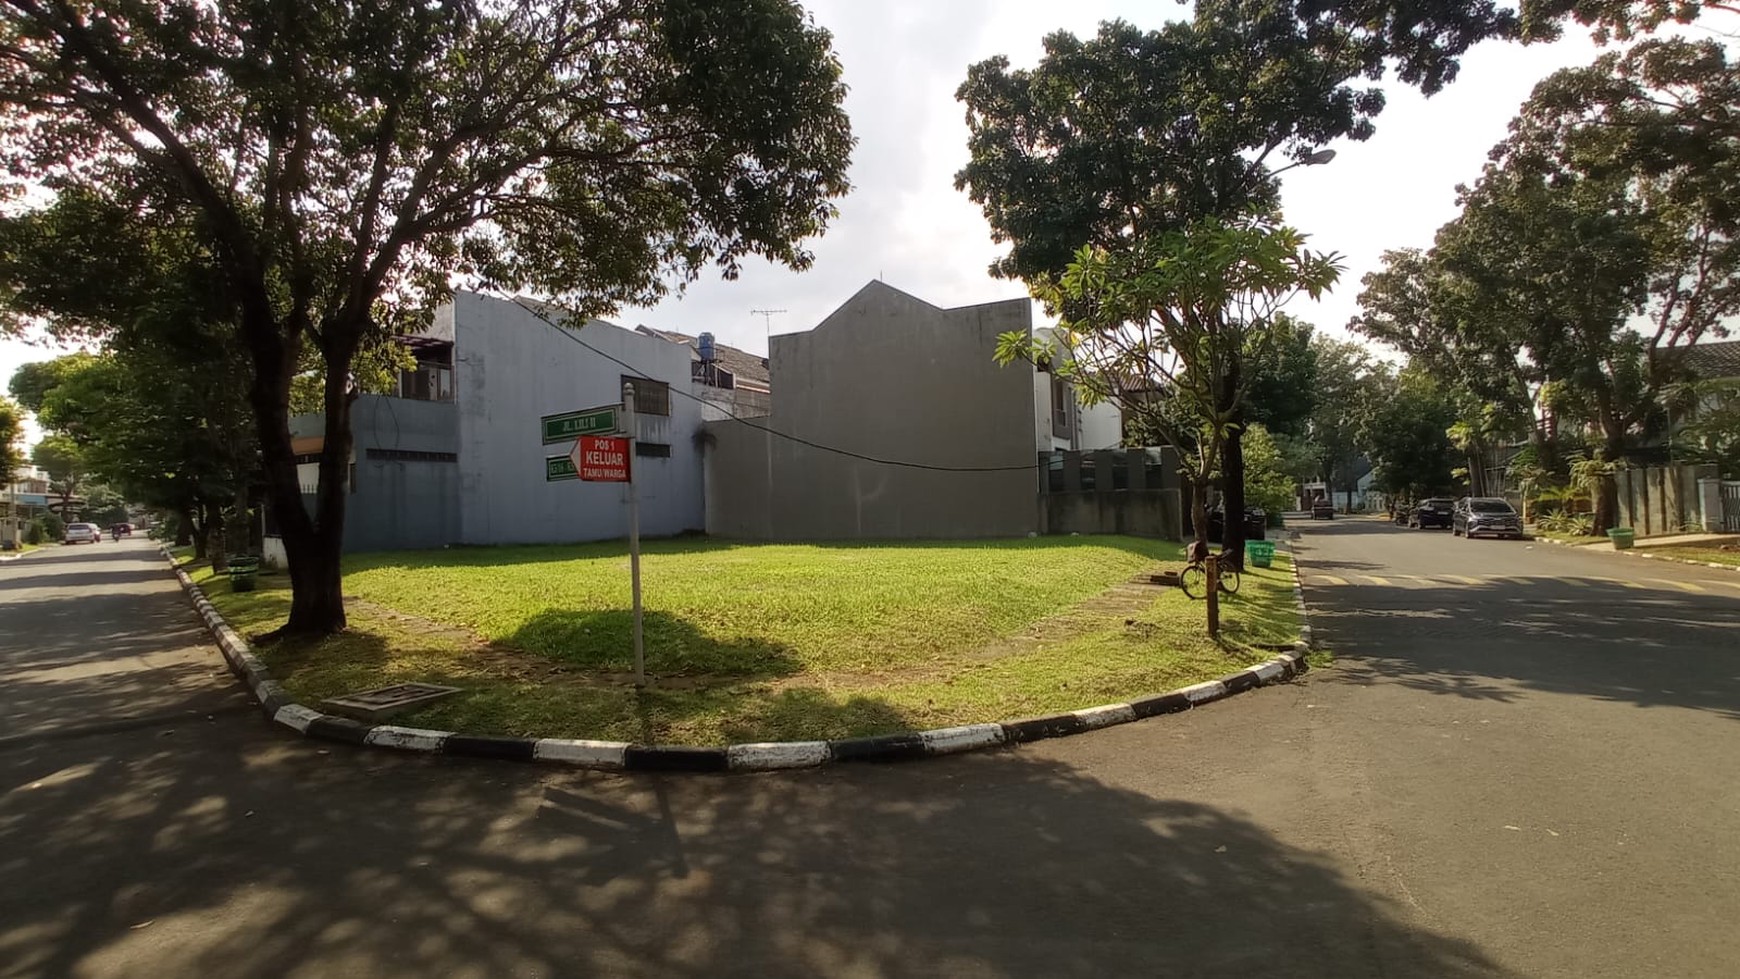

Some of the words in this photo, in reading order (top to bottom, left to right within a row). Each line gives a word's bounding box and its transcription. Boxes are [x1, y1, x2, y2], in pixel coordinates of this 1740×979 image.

[594, 440, 609, 450] POS
[611, 442, 615, 451] 1
[586, 451, 623, 465] KELUAR
